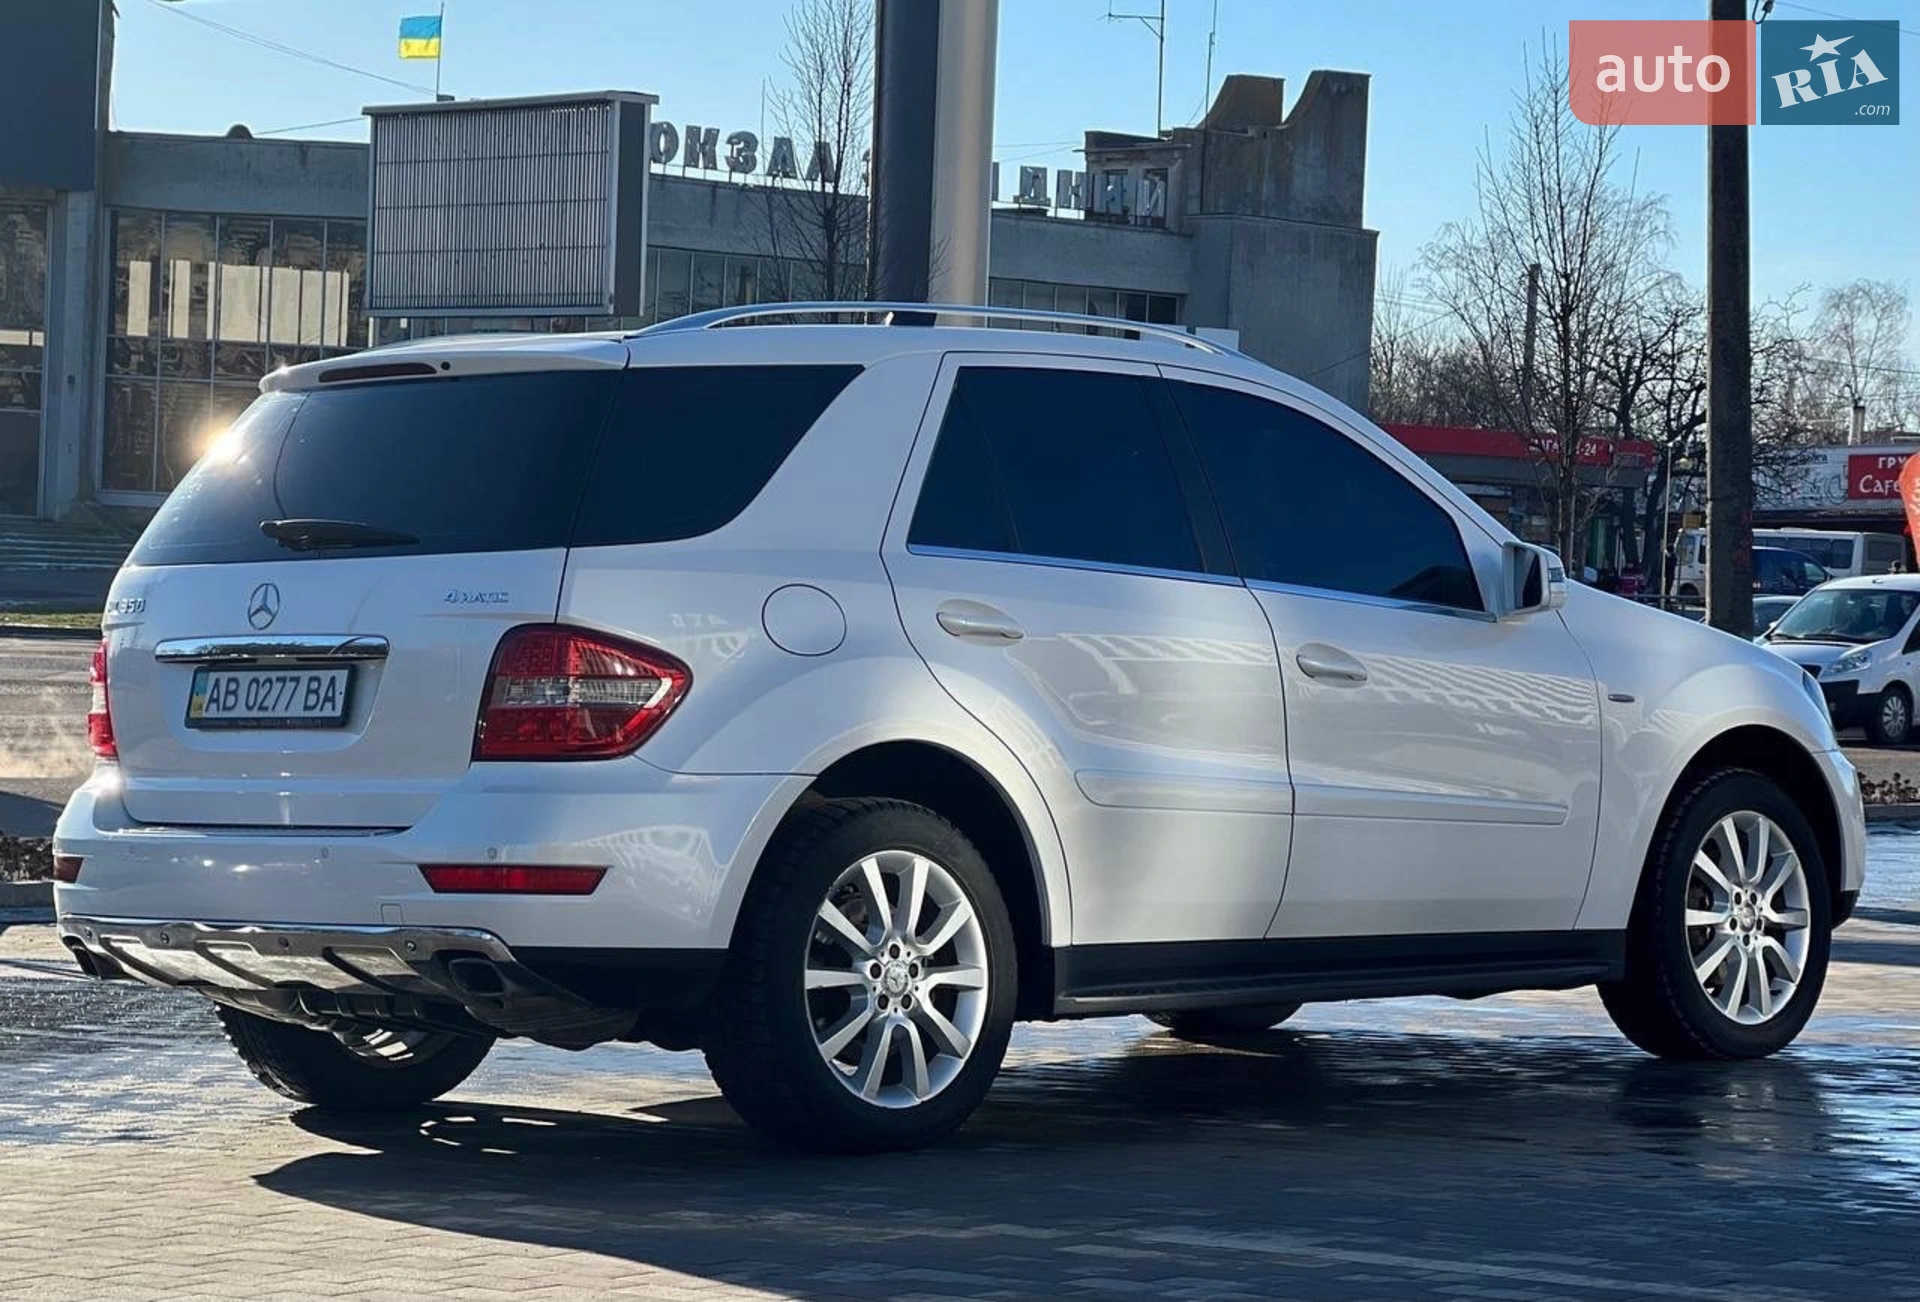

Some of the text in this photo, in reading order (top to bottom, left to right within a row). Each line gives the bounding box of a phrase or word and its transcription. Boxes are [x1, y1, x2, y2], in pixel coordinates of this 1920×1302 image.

[650, 121, 836, 183] ОКЗАЛ
[205, 675, 338, 713] AB 0277 BA
